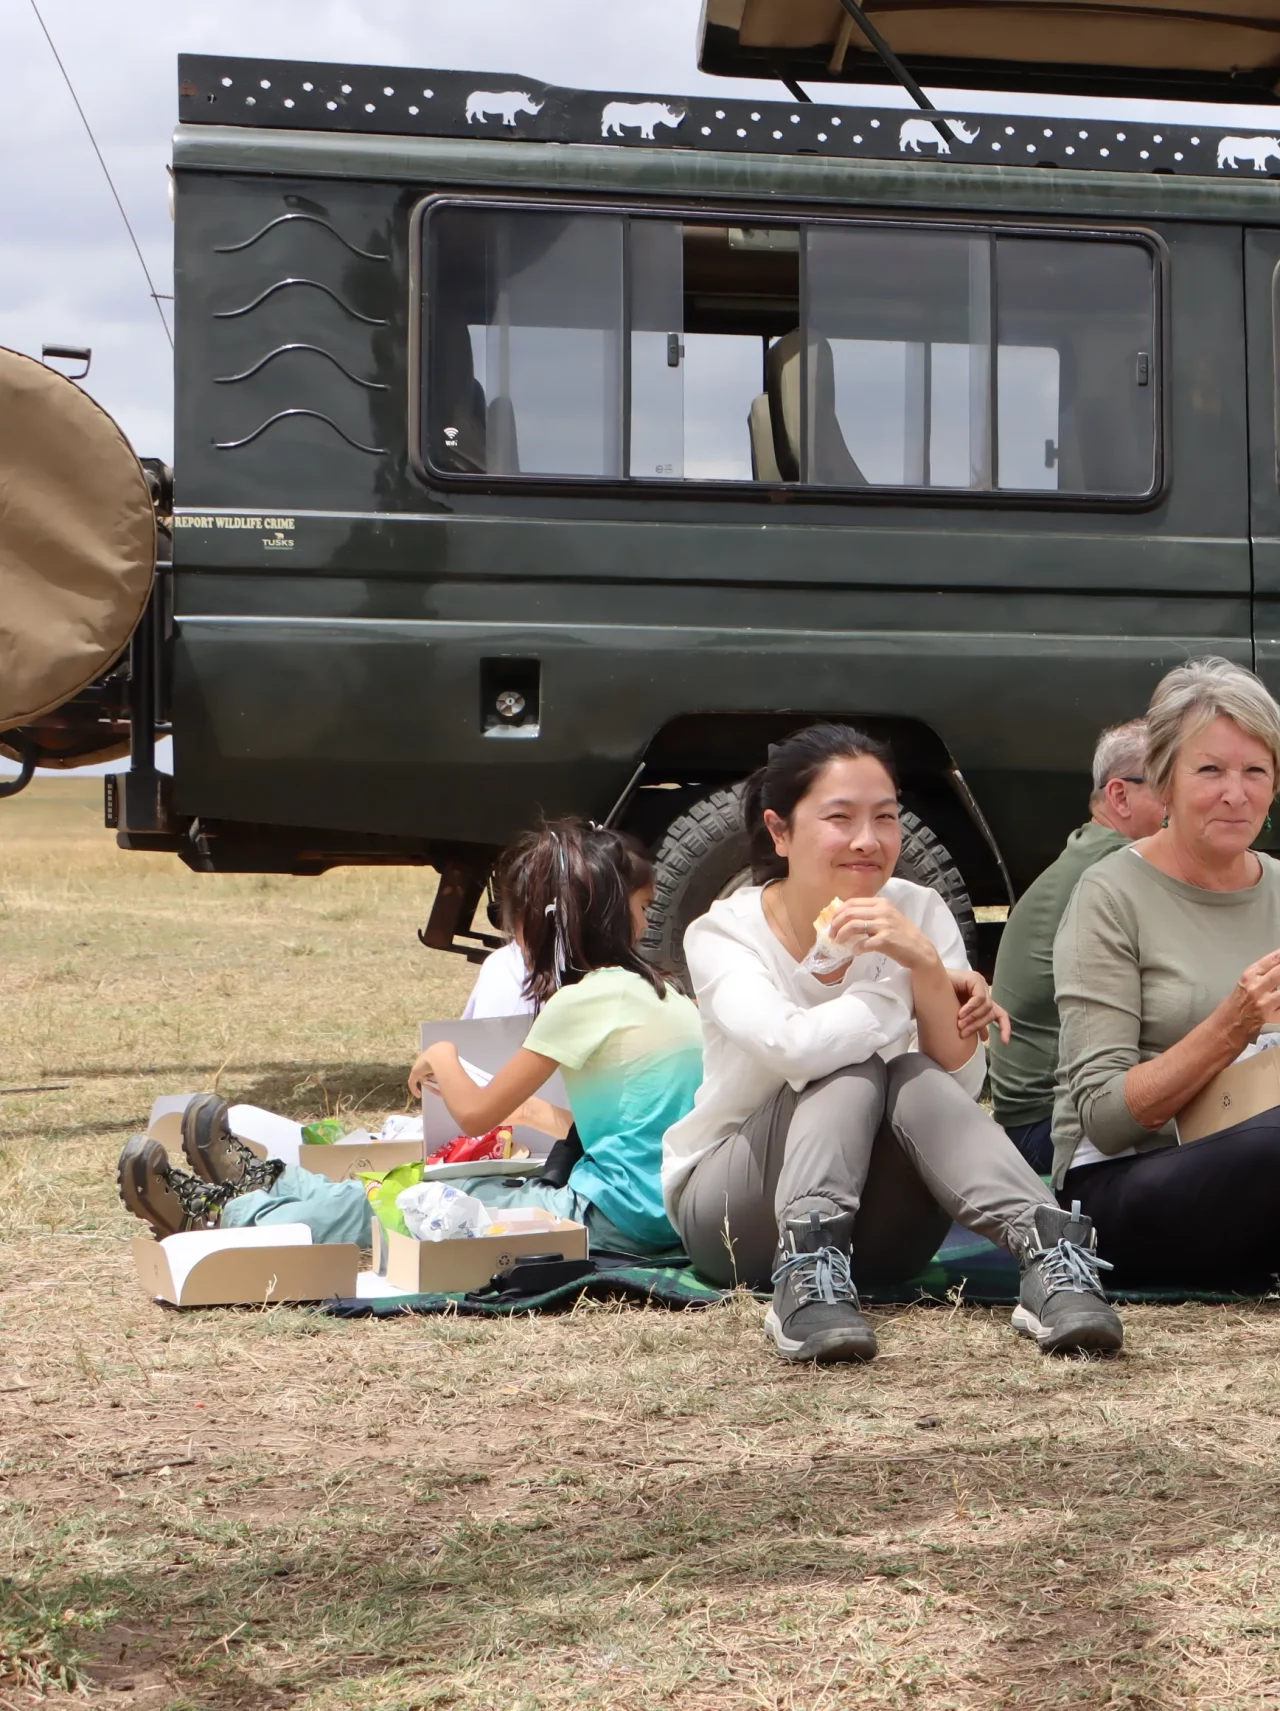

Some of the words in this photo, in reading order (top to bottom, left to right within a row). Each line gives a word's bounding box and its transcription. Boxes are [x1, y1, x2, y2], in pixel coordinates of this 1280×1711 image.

[174, 516, 214, 528] REPORT
[216, 517, 262, 529] WILDLIFE
[264, 518, 295, 530] CRIME
